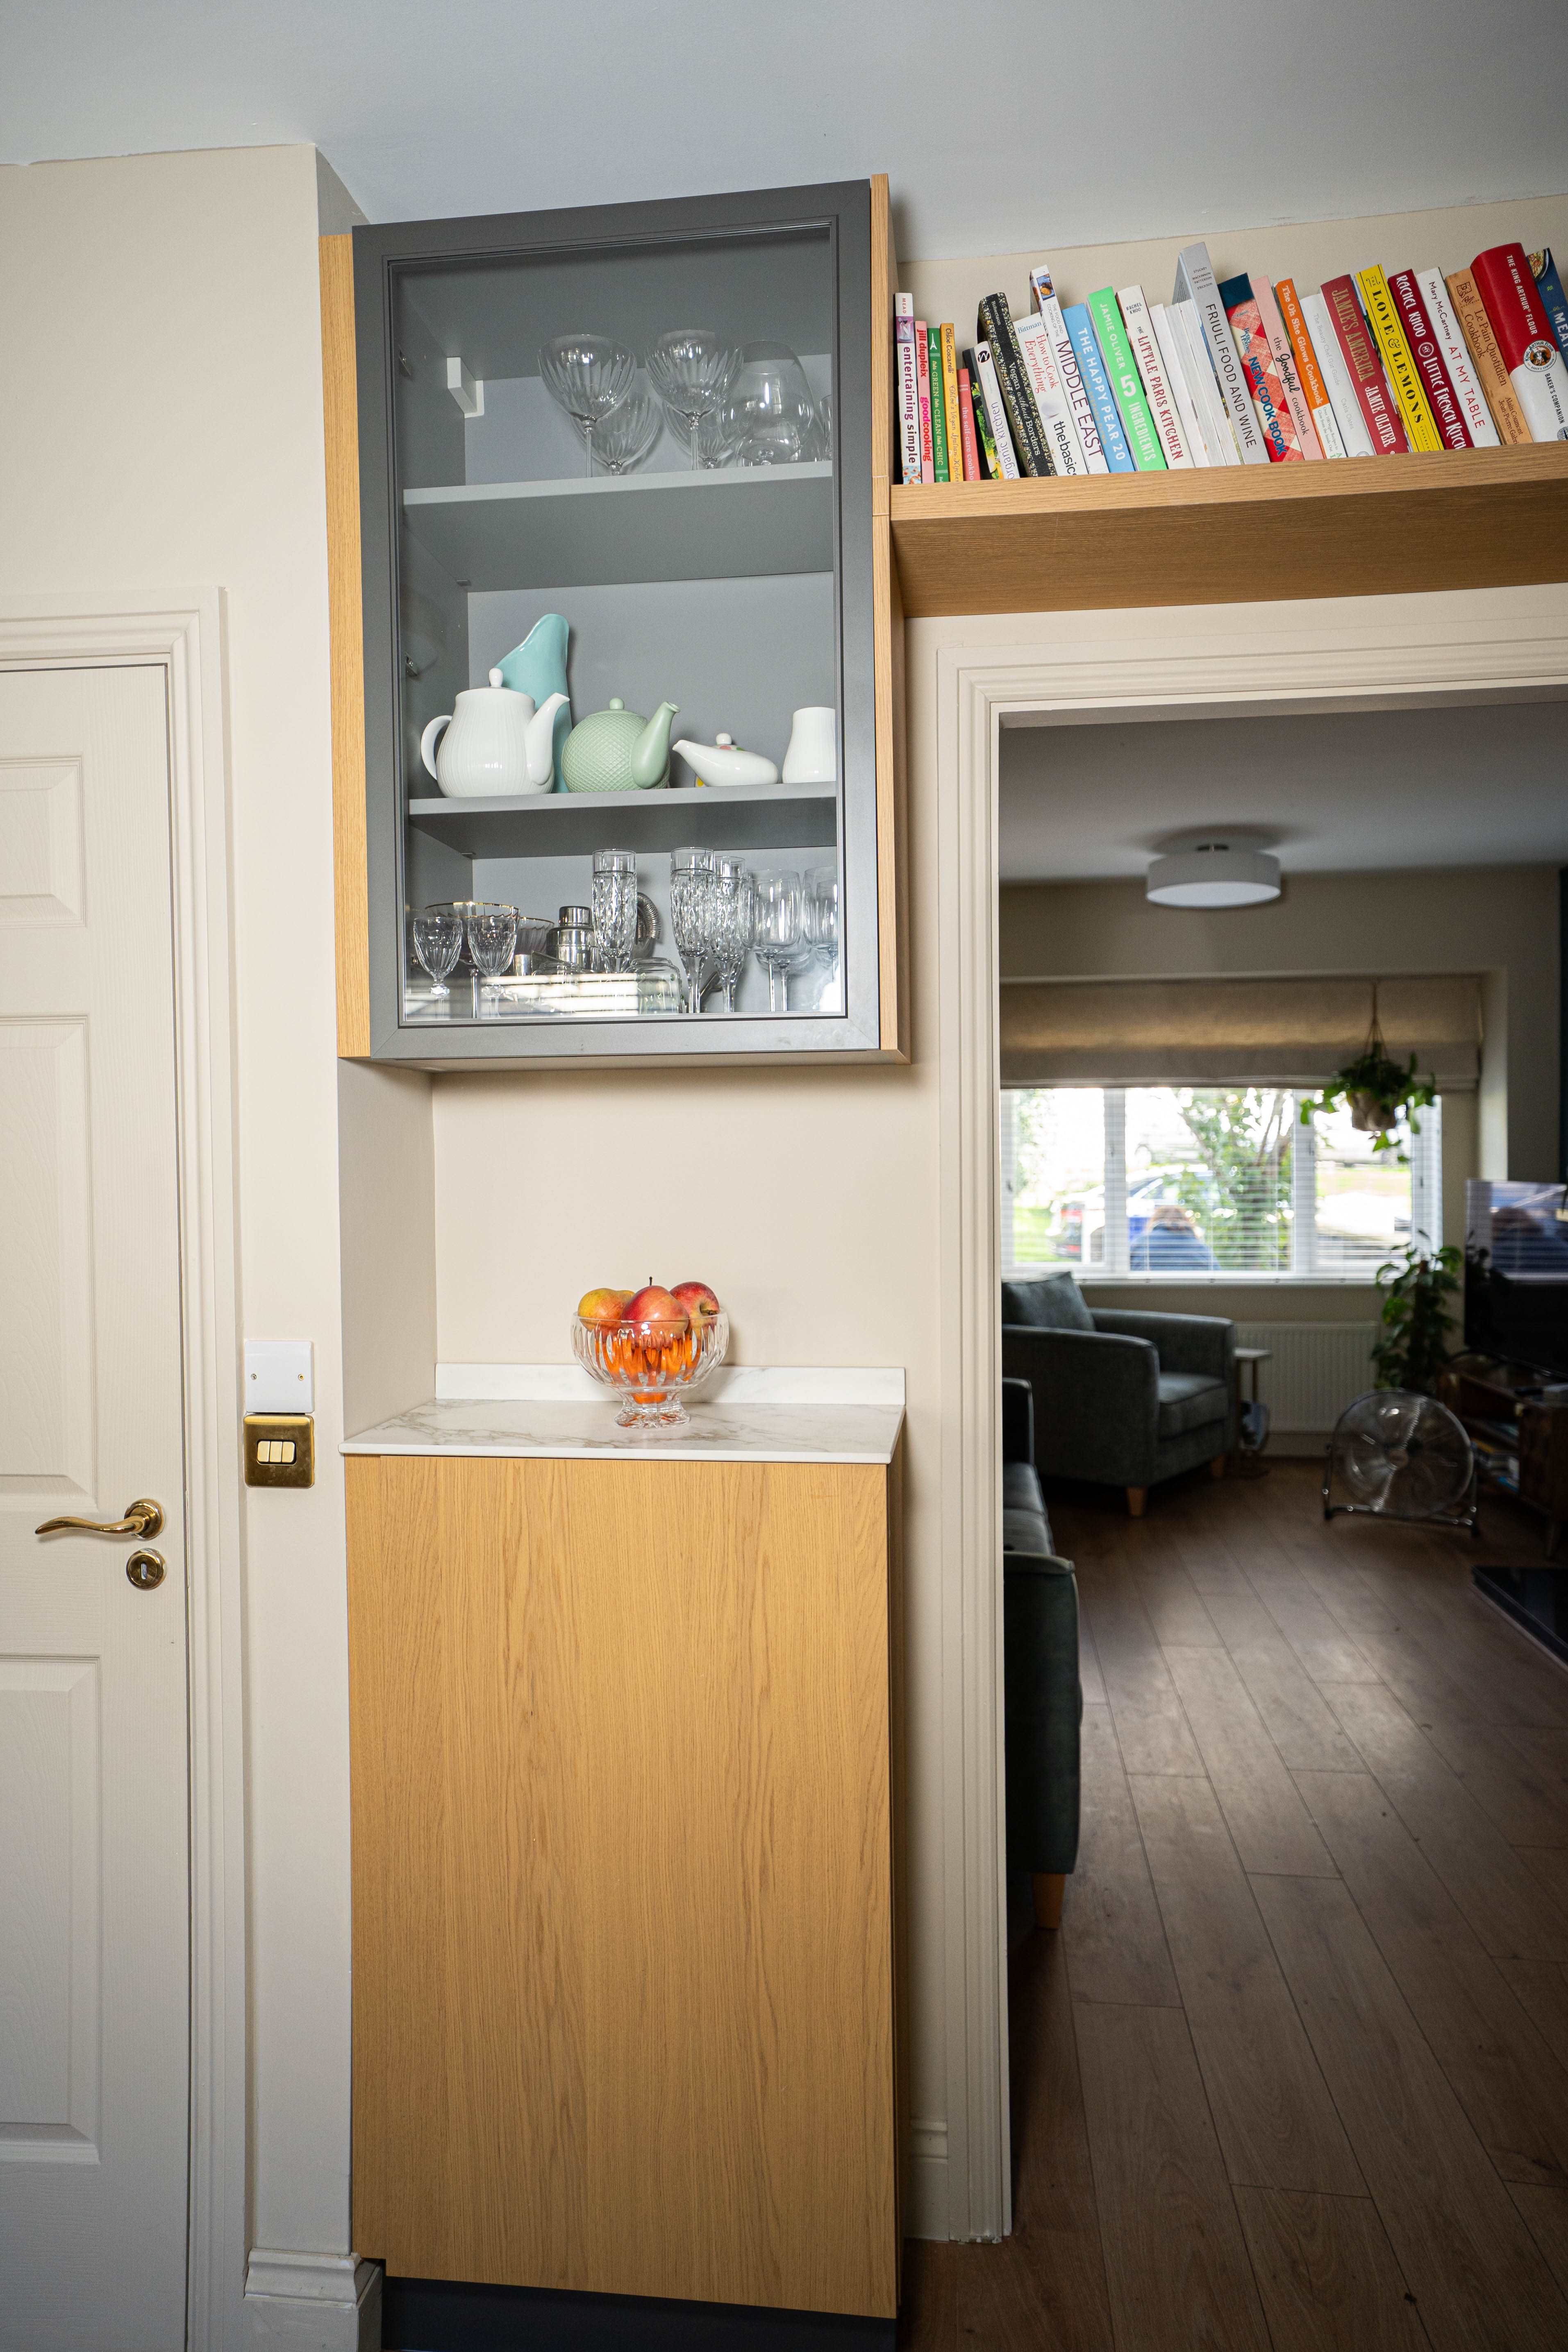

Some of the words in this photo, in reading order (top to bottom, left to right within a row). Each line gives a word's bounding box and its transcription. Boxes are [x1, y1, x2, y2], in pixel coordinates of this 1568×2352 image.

[1507, 255, 1516, 267] THE
[1511, 268, 1521, 284] KING
[1126, 302, 1142, 311] RACHEL
[1282, 285, 1291, 302] The
[1288, 303, 1297, 317] Oh
[1332, 288, 1359, 331] JAMIE'S
[1397, 275, 1417, 310] RACHEL
[1409, 311, 1426, 337] KHOO
[1429, 281, 1438, 300] Mary
[1436, 301, 1452, 340] McCartney
[992, 301, 1001, 325] Robertson
[1018, 321, 1042, 334] Bittman
[1292, 318, 1301, 335] She
[1373, 290, 1395, 335] LOVE
[1475, 308, 1484, 321] Le
[1479, 320, 1491, 342] Pain
[1526, 314, 1538, 335] FLOUR
[917, 329, 926, 341] jill
[1036, 334, 1047, 355] How
[1100, 304, 1114, 332] JAMIE
[1110, 334, 1125, 369] OLIVER
[1298, 336, 1309, 363] Glows
[1317, 325, 1326, 343] Beauty
[1323, 344, 1332, 358] Chef
[1388, 338, 1401, 348] &
[1465, 314, 1485, 359] Cookbook
[1529, 341, 1544, 351] ARTHUR
[1544, 341, 1554, 352] FLOUR
[918, 343, 927, 377] dupleix
[1025, 340, 1046, 393] Everything
[1043, 356, 1050, 366] to
[1076, 352, 1086, 373] DAVID
[1345, 332, 1375, 382] AMERICA
[1486, 343, 1507, 386] Quotidien
[904, 347, 915, 420] entertaining
[1046, 366, 1059, 389] Cook
[1078, 328, 1093, 354] THE
[1087, 357, 1109, 400] HAPPY
[1102, 405, 1119, 441] PEAR
[1113, 444, 1126, 460] 20
[1206, 304, 1225, 345] FRIULI
[1218, 347, 1236, 382] FOOD
[1229, 387, 1245, 412] AND
[1239, 414, 1257, 448] WINE
[1274, 337, 1282, 351] the
[1292, 398, 1309, 436] cookbook
[1305, 364, 1324, 406] Cookbook
[1393, 351, 1424, 423] LEMONS
[1423, 357, 1445, 389] LITTLE
[1434, 387, 1457, 423] FRENCH
[1448, 347, 1462, 360] AT
[1456, 365, 1470, 383] MY
[1464, 388, 1485, 429] TABLE
[1009, 362, 1020, 389] Vegan
[1017, 392, 1029, 420] without
[1026, 420, 1041, 456] Borders
[1056, 340, 1089, 411] MIDDLE
[1078, 413, 1103, 456] EAST
[1138, 335, 1158, 374] LITTLE
[1150, 376, 1167, 407] PARIS
[1159, 409, 1184, 461] KITCHEN
[1248, 356, 1266, 385] NEW
[1258, 386, 1276, 422] COOK
[1268, 421, 1288, 455] BOOK
[1365, 386, 1386, 414] JAMIE
[1498, 400, 1512, 429] Jean-Pierre
[1505, 397, 1514, 411] Alain
[1511, 411, 1524, 435] Coumont
[1545, 373, 1556, 394] BAKER'S
[1551, 395, 1565, 424] COMPANION
[949, 411, 957, 430] Vegan
[991, 402, 1006, 441] kitchen
[1120, 374, 1136, 397] 5
[1128, 402, 1157, 462] INGREDIENTS
[1346, 414, 1354, 430] Oates
[1375, 413, 1396, 448] OLIVER
[906, 425, 917, 463] simple
[1000, 442, 1015, 479] organic
